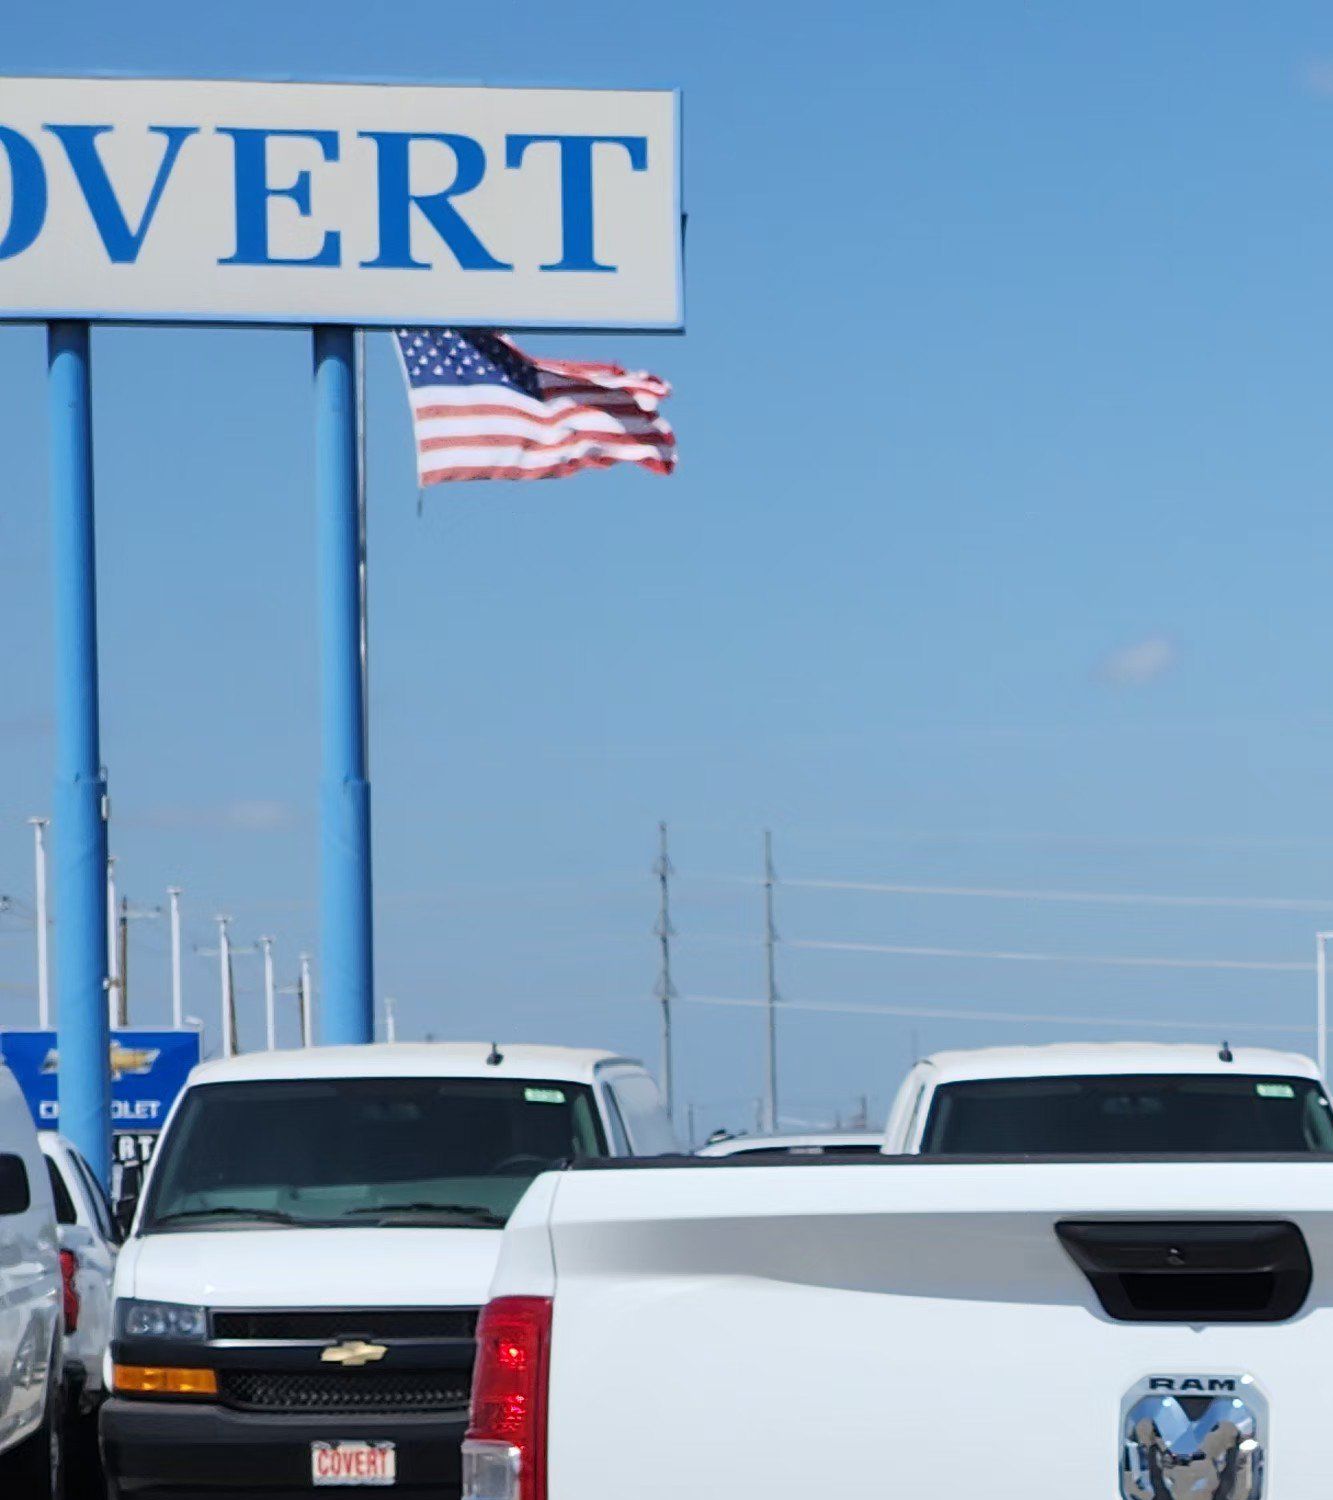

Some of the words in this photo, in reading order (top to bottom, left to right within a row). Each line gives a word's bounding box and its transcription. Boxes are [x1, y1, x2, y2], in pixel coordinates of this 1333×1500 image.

[39, 1100, 161, 1119] COLET
[1149, 1378, 1236, 1391] RAM
[318, 1449, 387, 1477] COVERT
